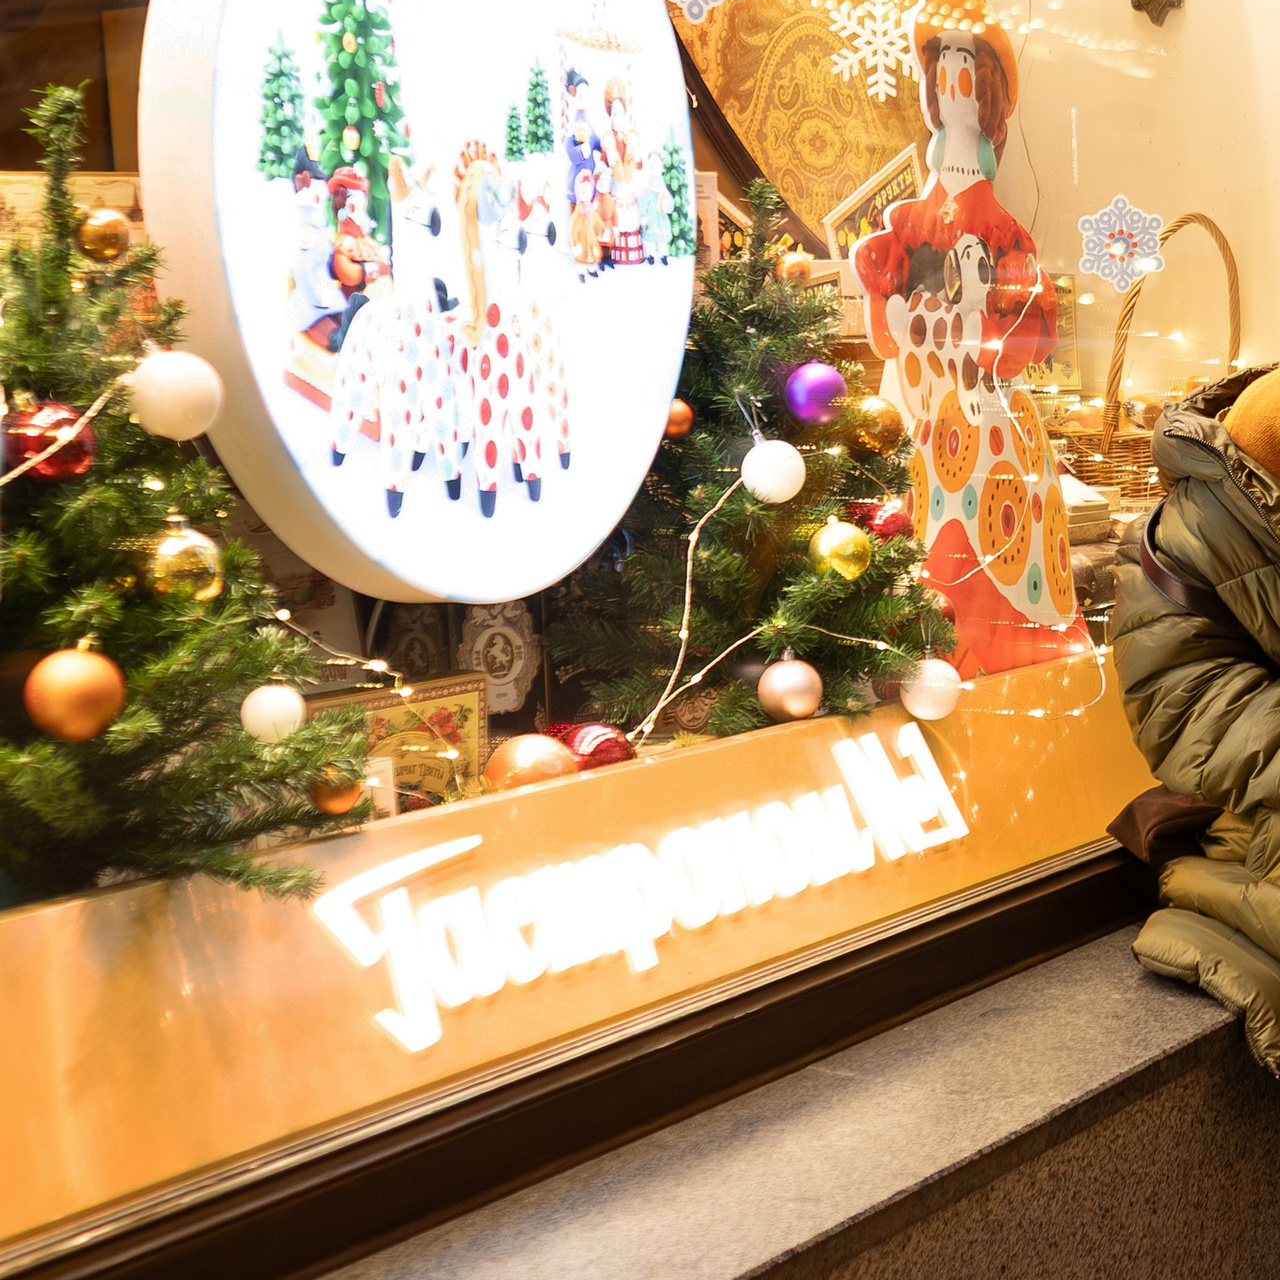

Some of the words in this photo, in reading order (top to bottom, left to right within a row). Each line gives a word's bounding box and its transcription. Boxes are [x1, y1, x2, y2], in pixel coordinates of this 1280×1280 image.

[874, 168, 914, 210] ФРУКТЫ
[311, 783, 876, 1053] Гастроном
[830, 721, 971, 862] №1
